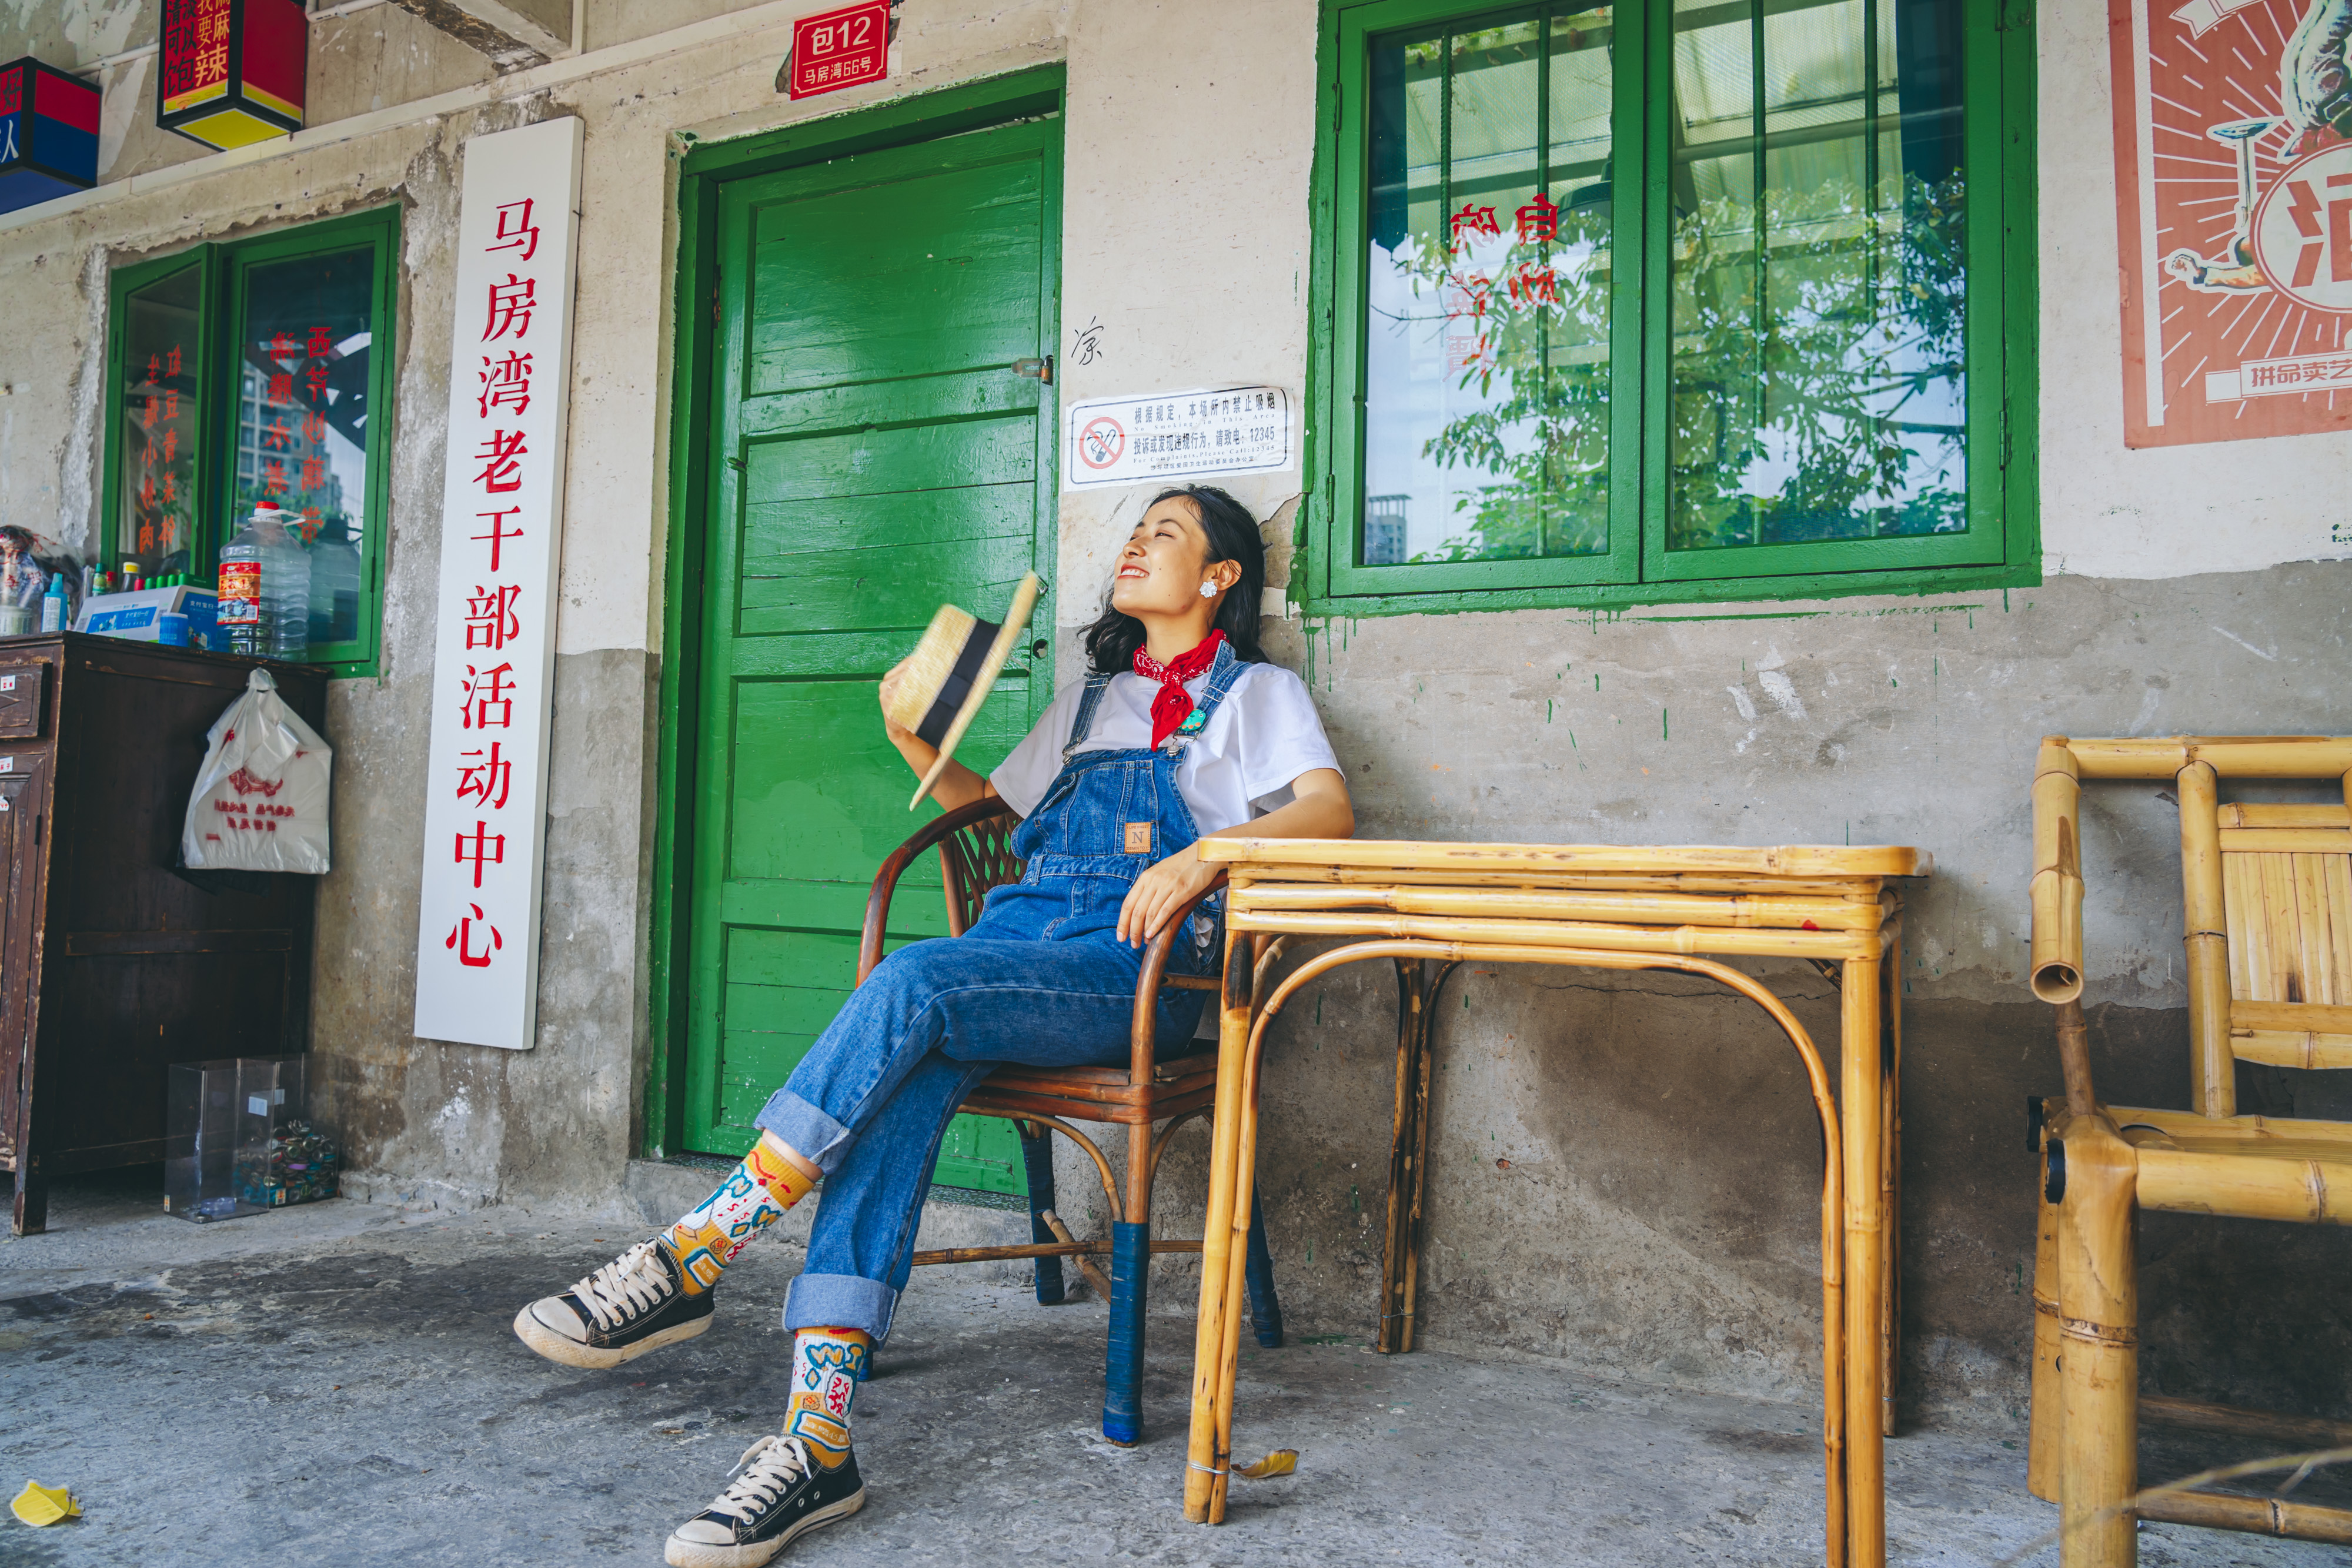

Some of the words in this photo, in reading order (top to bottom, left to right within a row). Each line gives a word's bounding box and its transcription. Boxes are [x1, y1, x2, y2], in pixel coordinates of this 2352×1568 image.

[811, 16, 871, 55] 包12
[804, 56, 871, 85] 马房湾66号
[2251, 359, 2352, 387] 拼命卖艺
[446, 198, 540, 968] 马房湾老干部活动中心
[1131, 831, 1144, 844] N
